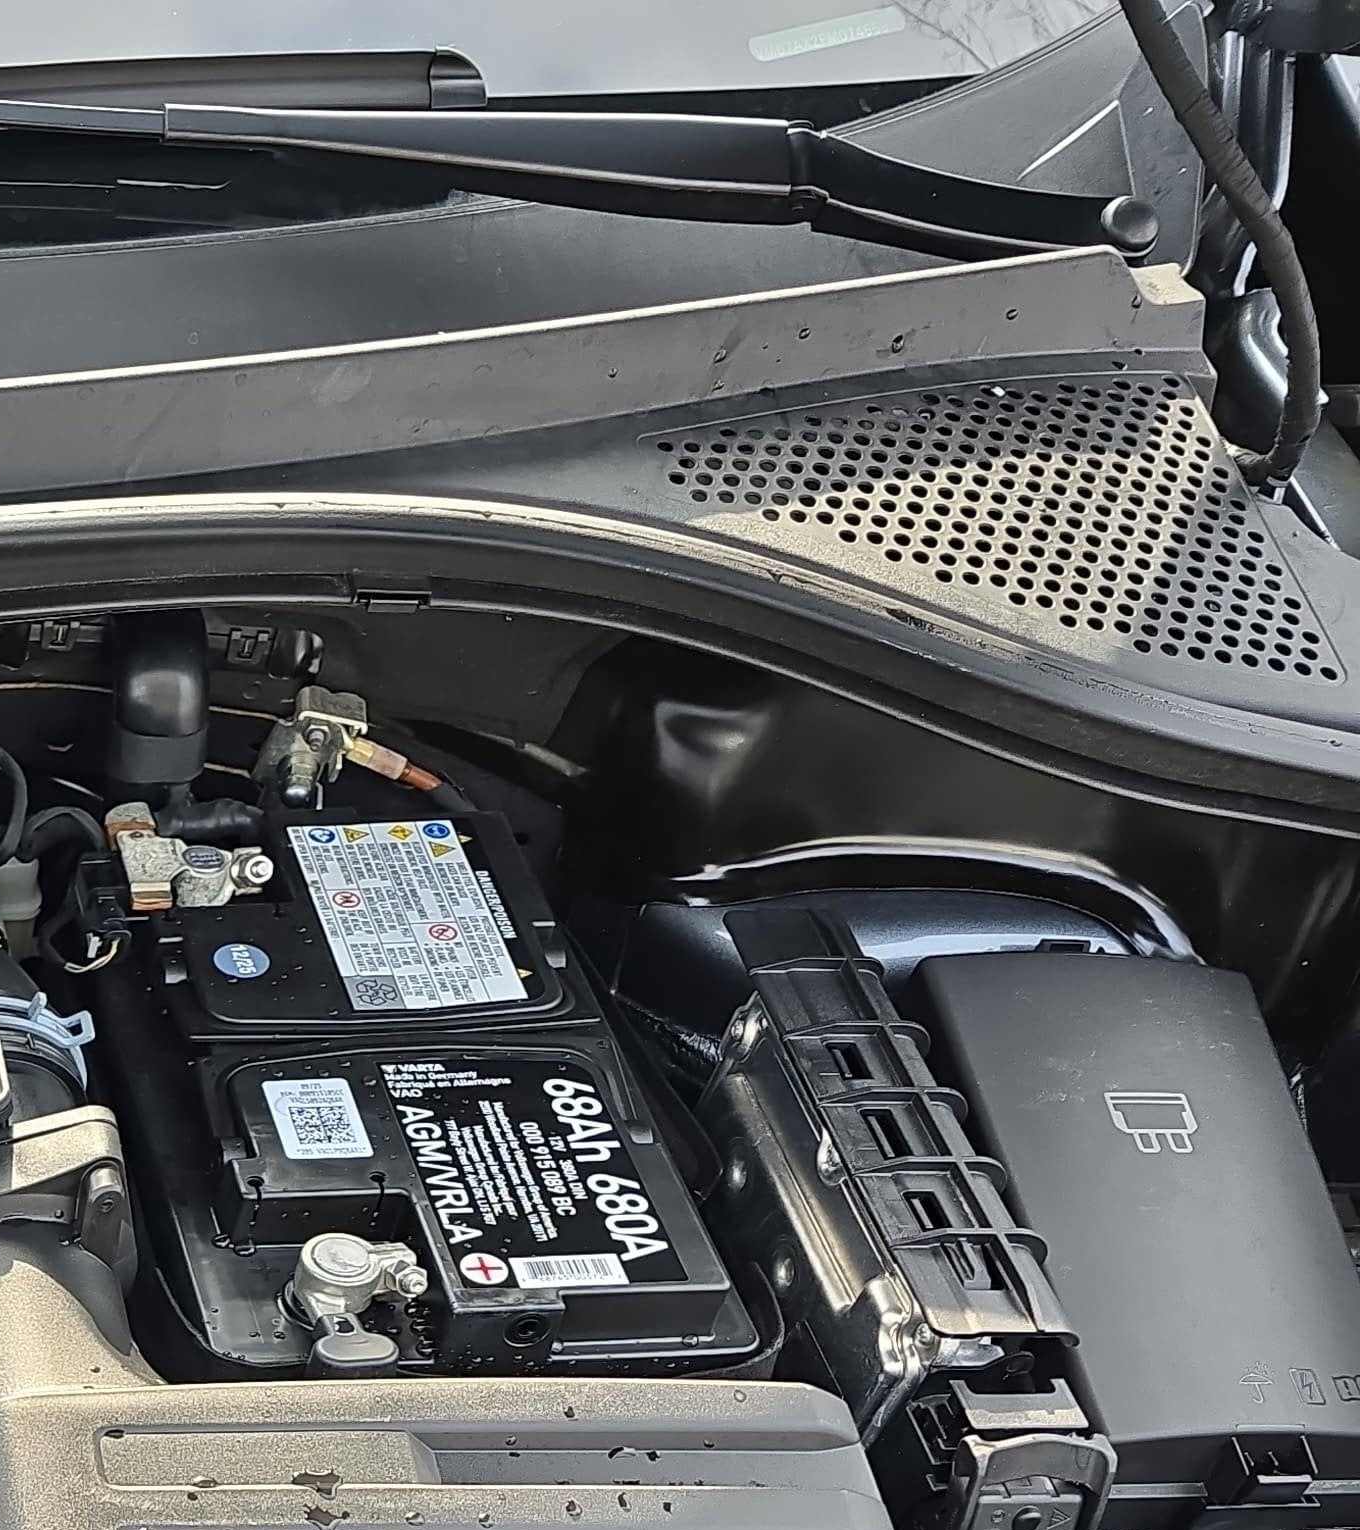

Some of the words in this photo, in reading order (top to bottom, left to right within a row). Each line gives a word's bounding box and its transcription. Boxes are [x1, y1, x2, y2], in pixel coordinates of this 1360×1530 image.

[475, 871, 517, 939] DANGER/POISON
[230, 945, 256, 973] 12/25
[397, 1064, 445, 1073] VARTA
[517, 1121, 546, 1143] 000
[529, 1147, 556, 1168] 915
[543, 1079, 621, 1162] 68Ah
[587, 1173, 669, 1261] 680A
[547, 1136, 567, 1151] 12V
[568, 1183, 588, 1199] DIN
[396, 1105, 483, 1244] AGM/VRLA
[538, 1171, 567, 1193] 089
[550, 1197, 577, 1215] BC
